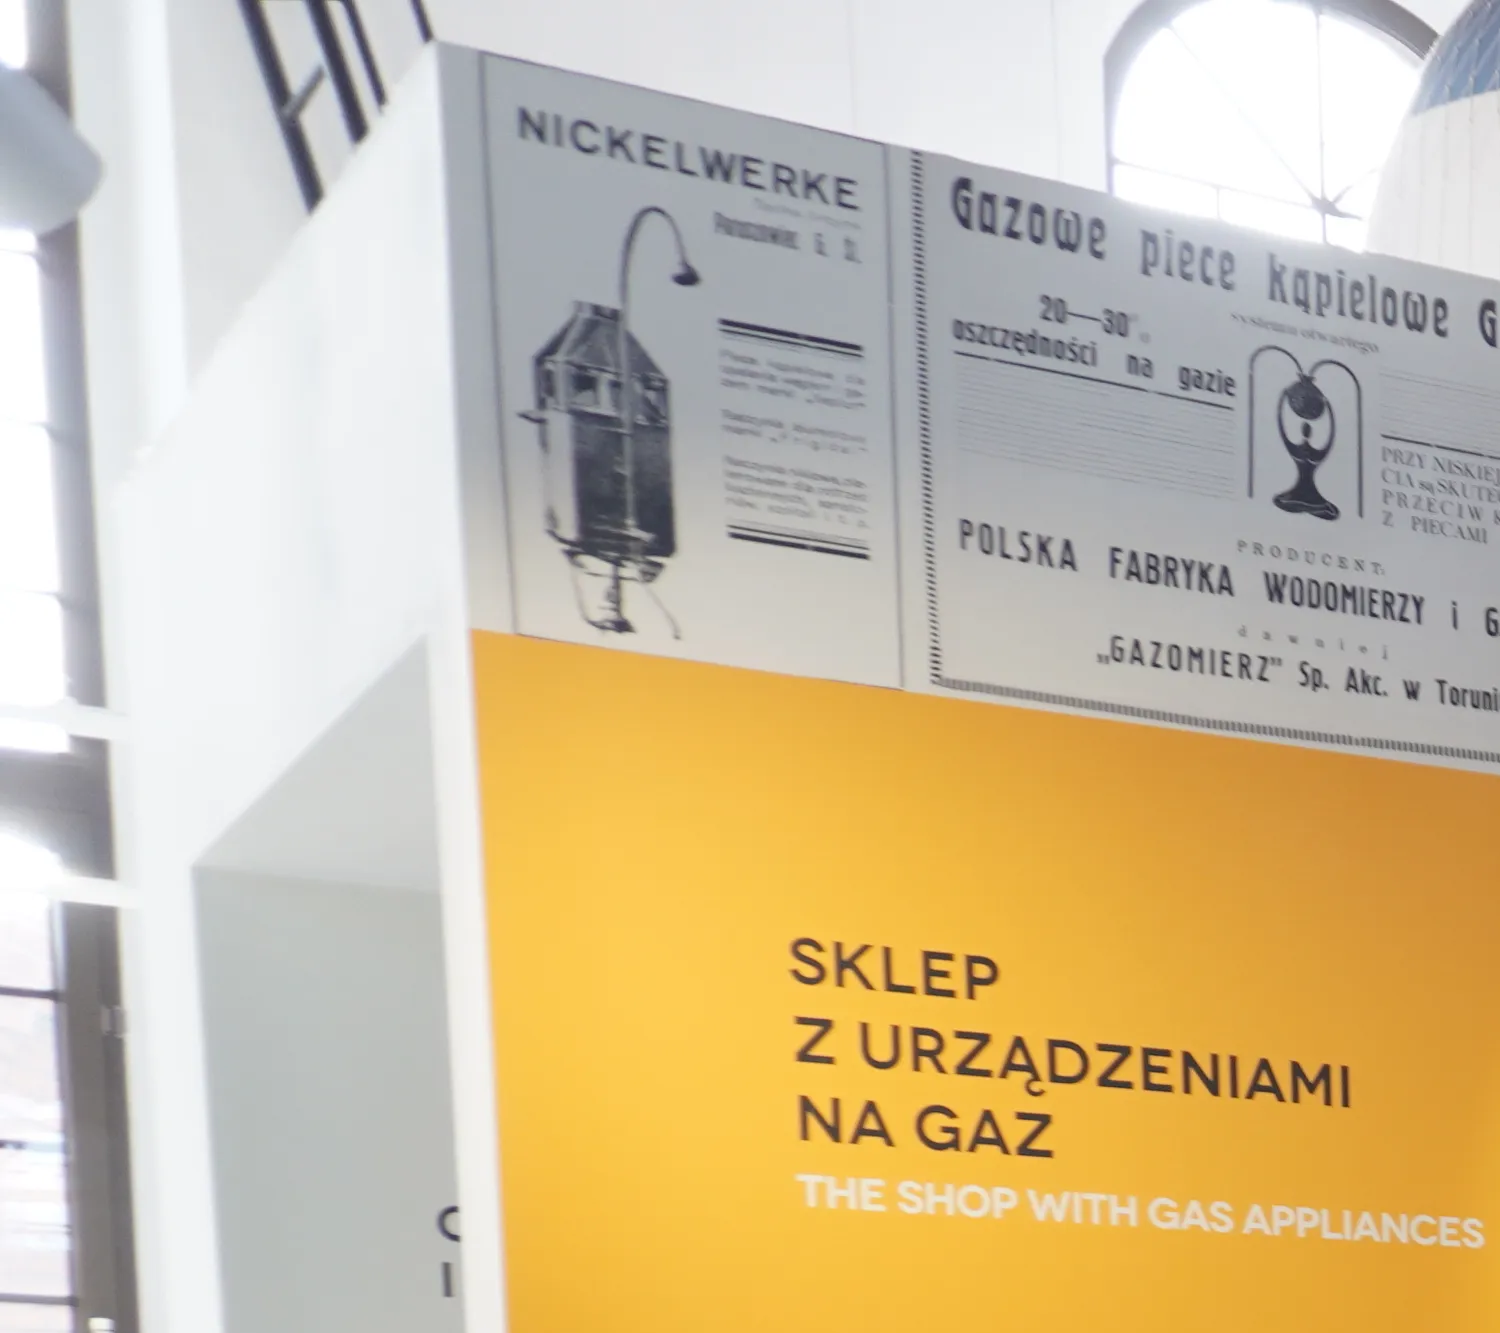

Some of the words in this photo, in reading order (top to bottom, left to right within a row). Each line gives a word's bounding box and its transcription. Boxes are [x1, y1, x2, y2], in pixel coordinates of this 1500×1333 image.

[516, 105, 860, 211] NICKELWERKE
[950, 176, 1108, 260] Gazowe
[1139, 228, 1236, 291] piece
[1268, 252, 1449, 338] kąpielowe
[952, 317, 1098, 368] oszczędności
[1126, 353, 1154, 379] na
[1178, 364, 1236, 396] gazie
[1381, 446, 1428, 470] PRZY
[1381, 489, 1483, 522] PRZECIW
[1411, 516, 1488, 545] PIECAMI
[958, 519, 1077, 572] POLSKA
[1109, 547, 1235, 598] FABRYKA
[1264, 573, 1425, 625] WODOMIERZY
[1298, 661, 1329, 692] Sp.
[1345, 669, 1388, 698] Akc.
[788, 937, 999, 1000] SKLEP
[793, 1016, 835, 1065] Z
[858, 1021, 1352, 1108] URZĄDZENIAMI
[797, 1095, 896, 1148] NA
[914, 1105, 1055, 1159] GAZ
[796, 1173, 886, 1213] THE
[897, 1181, 1018, 1219] SHOP
[1027, 1189, 1138, 1227] WITH
[1147, 1198, 1235, 1235] GAS
[1242, 1204, 1486, 1249] APPLIANCES
